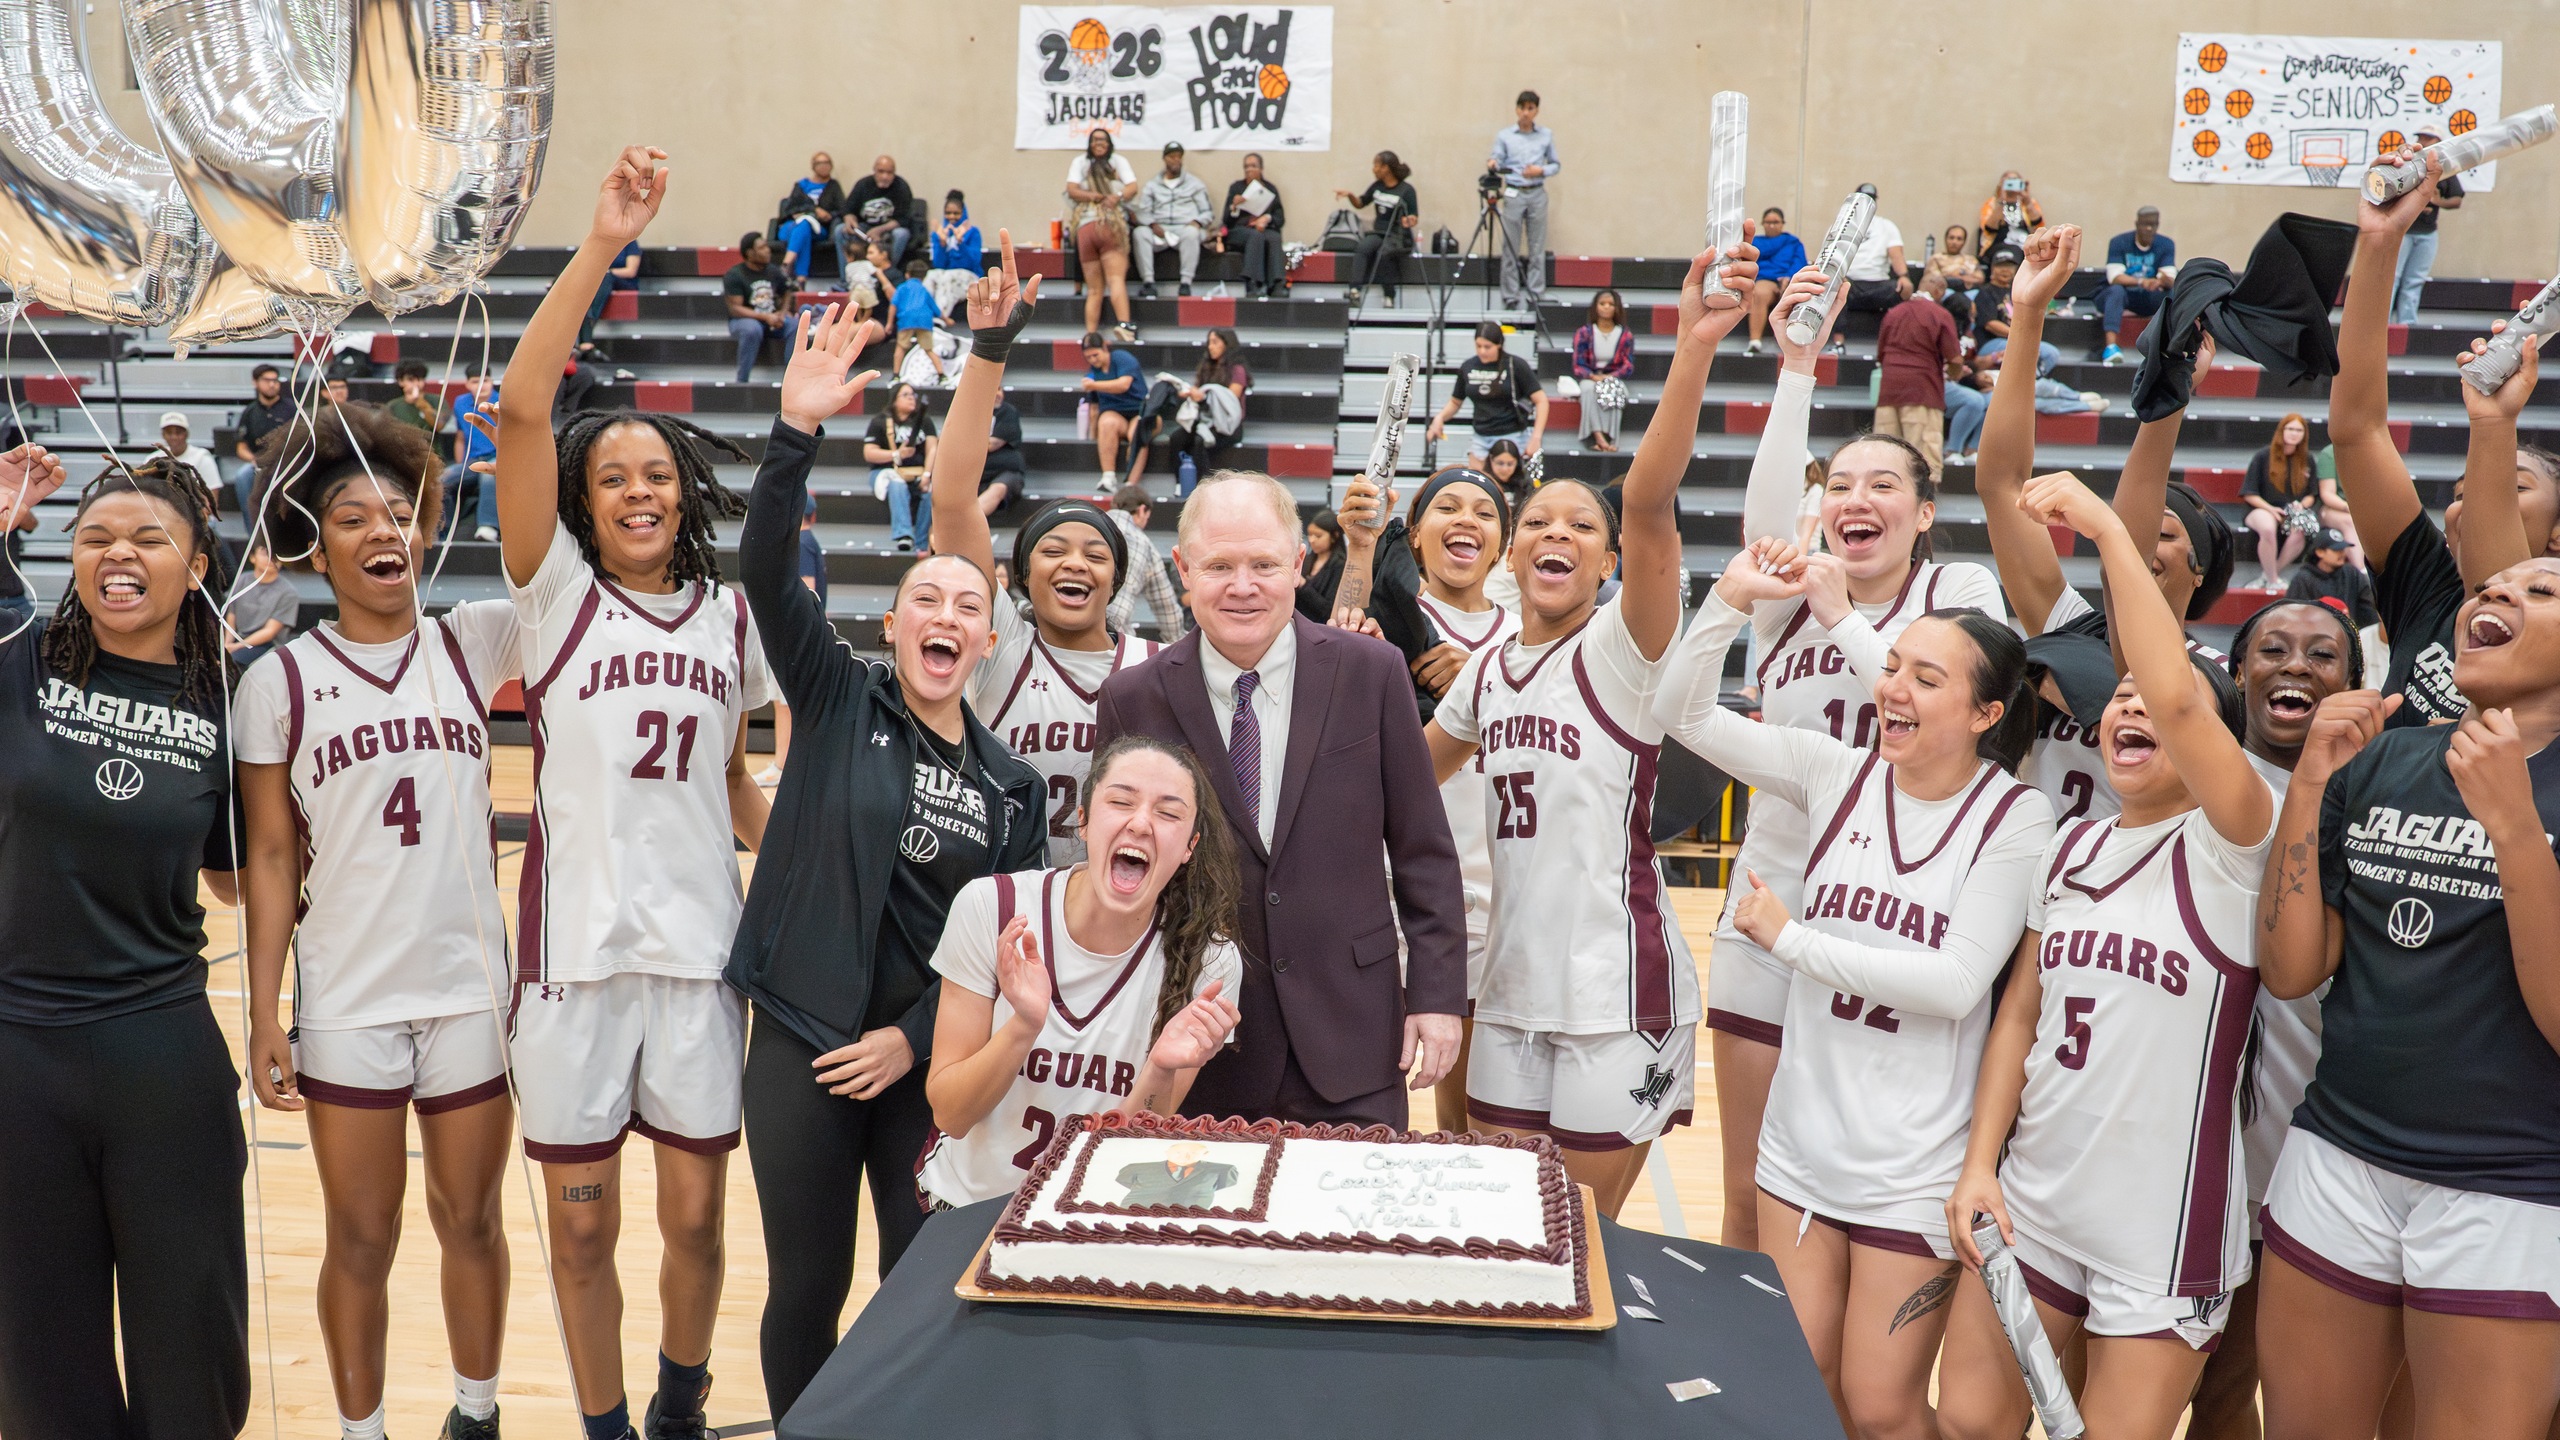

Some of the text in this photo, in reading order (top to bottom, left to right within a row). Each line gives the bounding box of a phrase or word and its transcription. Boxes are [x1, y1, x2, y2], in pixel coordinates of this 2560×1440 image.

[1047, 92, 1145, 125] JAGUARS
[2290, 86, 2399, 119] SENIORS
[579, 651, 733, 711] JAGUAR
[1775, 644, 1858, 690] JAG
[37, 677, 218, 752] JAGUARS
[1480, 714, 1581, 761] GUARS
[45, 719, 202, 773] WOMEN'S BASKETBALL
[312, 716, 483, 789] JAGUARS
[630, 710, 699, 782] 21
[383, 776, 421, 847] 4
[1492, 770, 1537, 840] 25
[2344, 837, 2374, 853] TEXAS
[2347, 858, 2407, 885] WOMEN'S
[2055, 996, 2096, 1071] 5
[1018, 1047, 1136, 1097] GUAR
[1318, 1170, 1405, 1192] Coach
